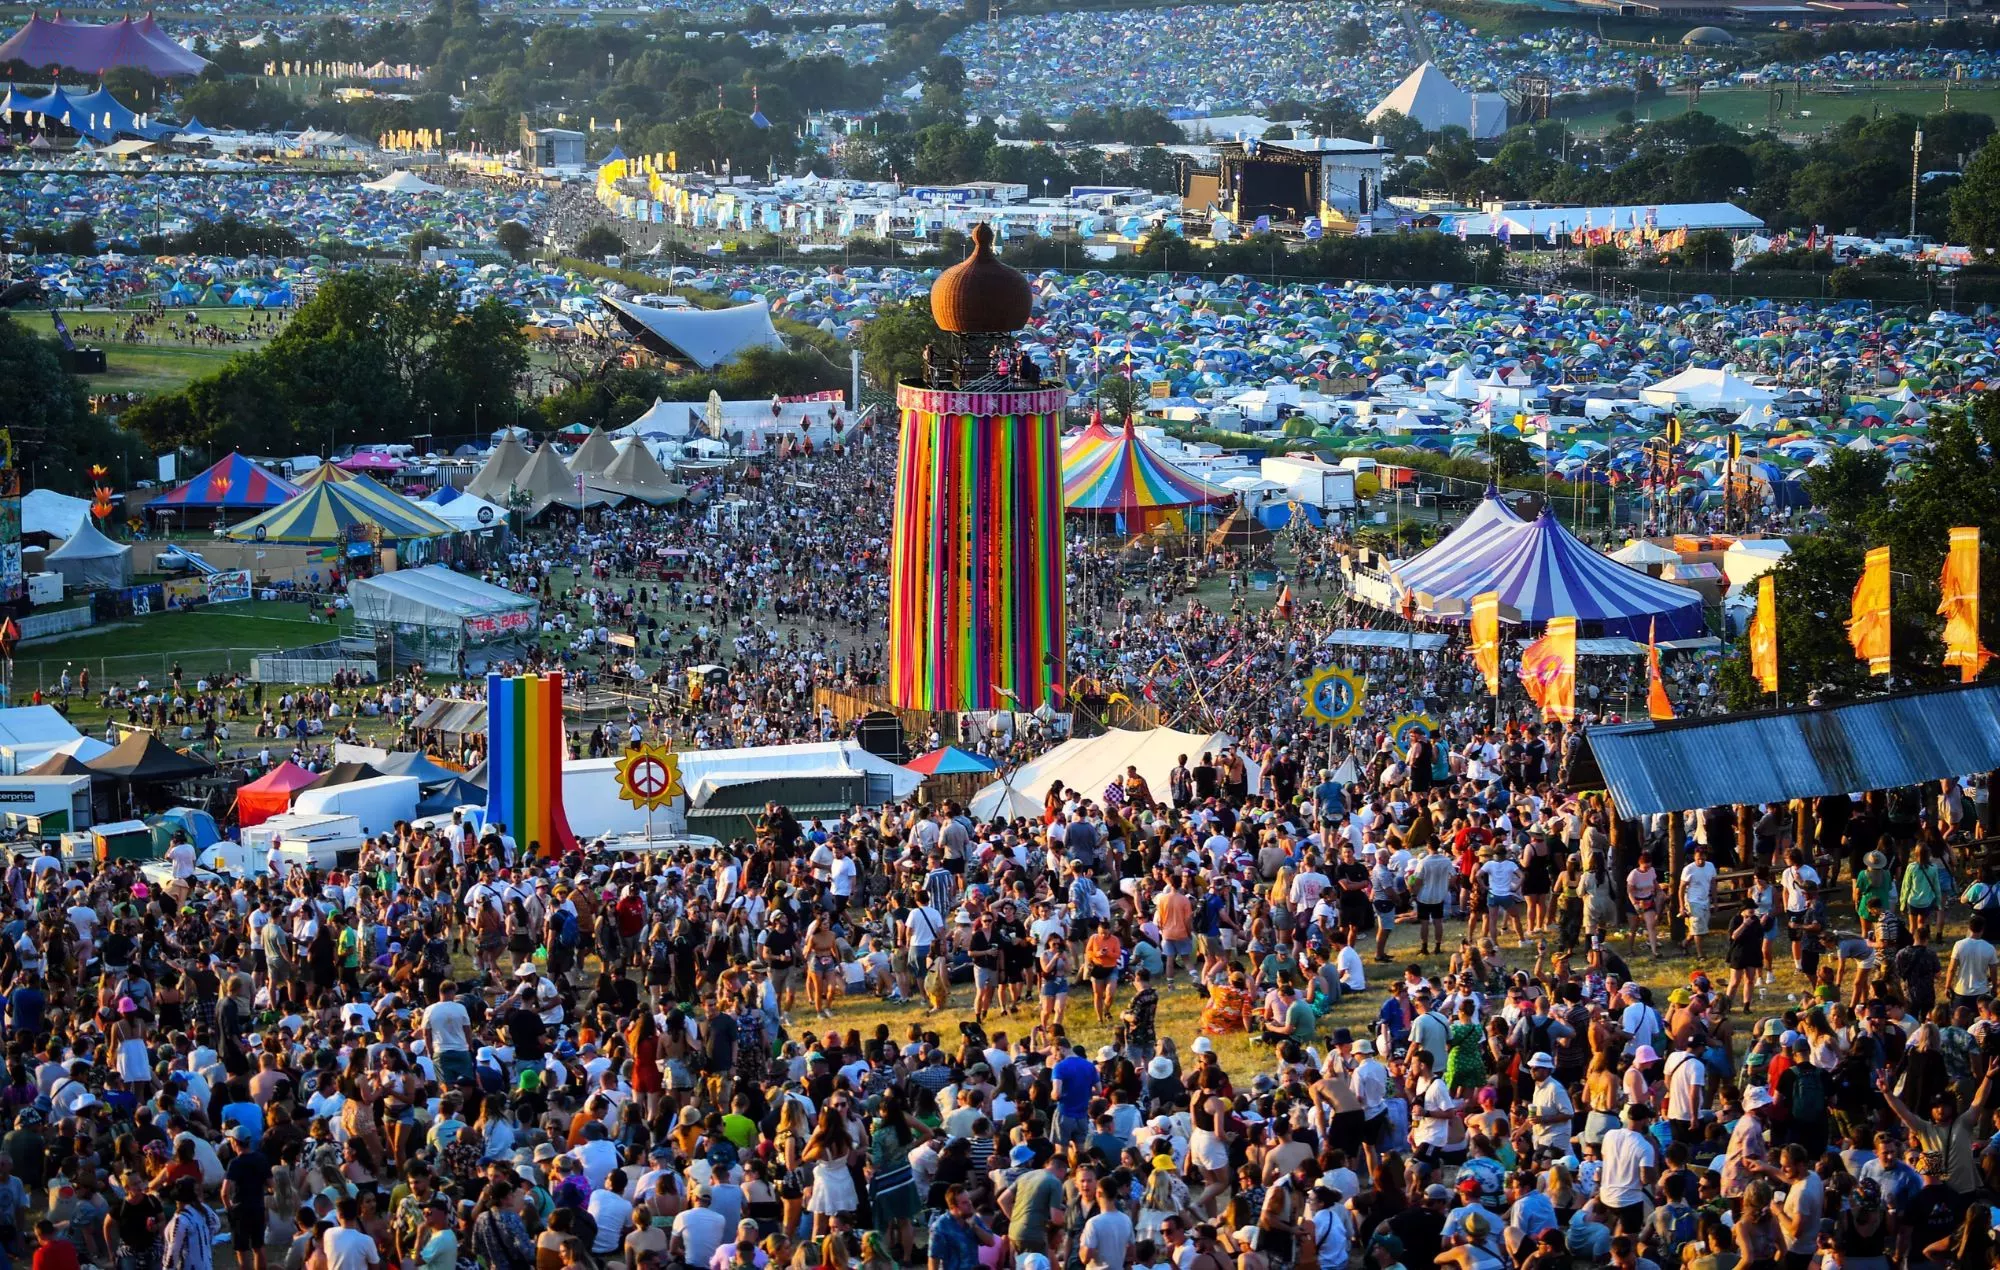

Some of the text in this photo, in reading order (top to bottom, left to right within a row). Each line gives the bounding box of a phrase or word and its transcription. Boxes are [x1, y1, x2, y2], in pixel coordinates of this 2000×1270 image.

[923, 192, 963, 200] MARITIME
[474, 612, 529, 631] THE PARK
